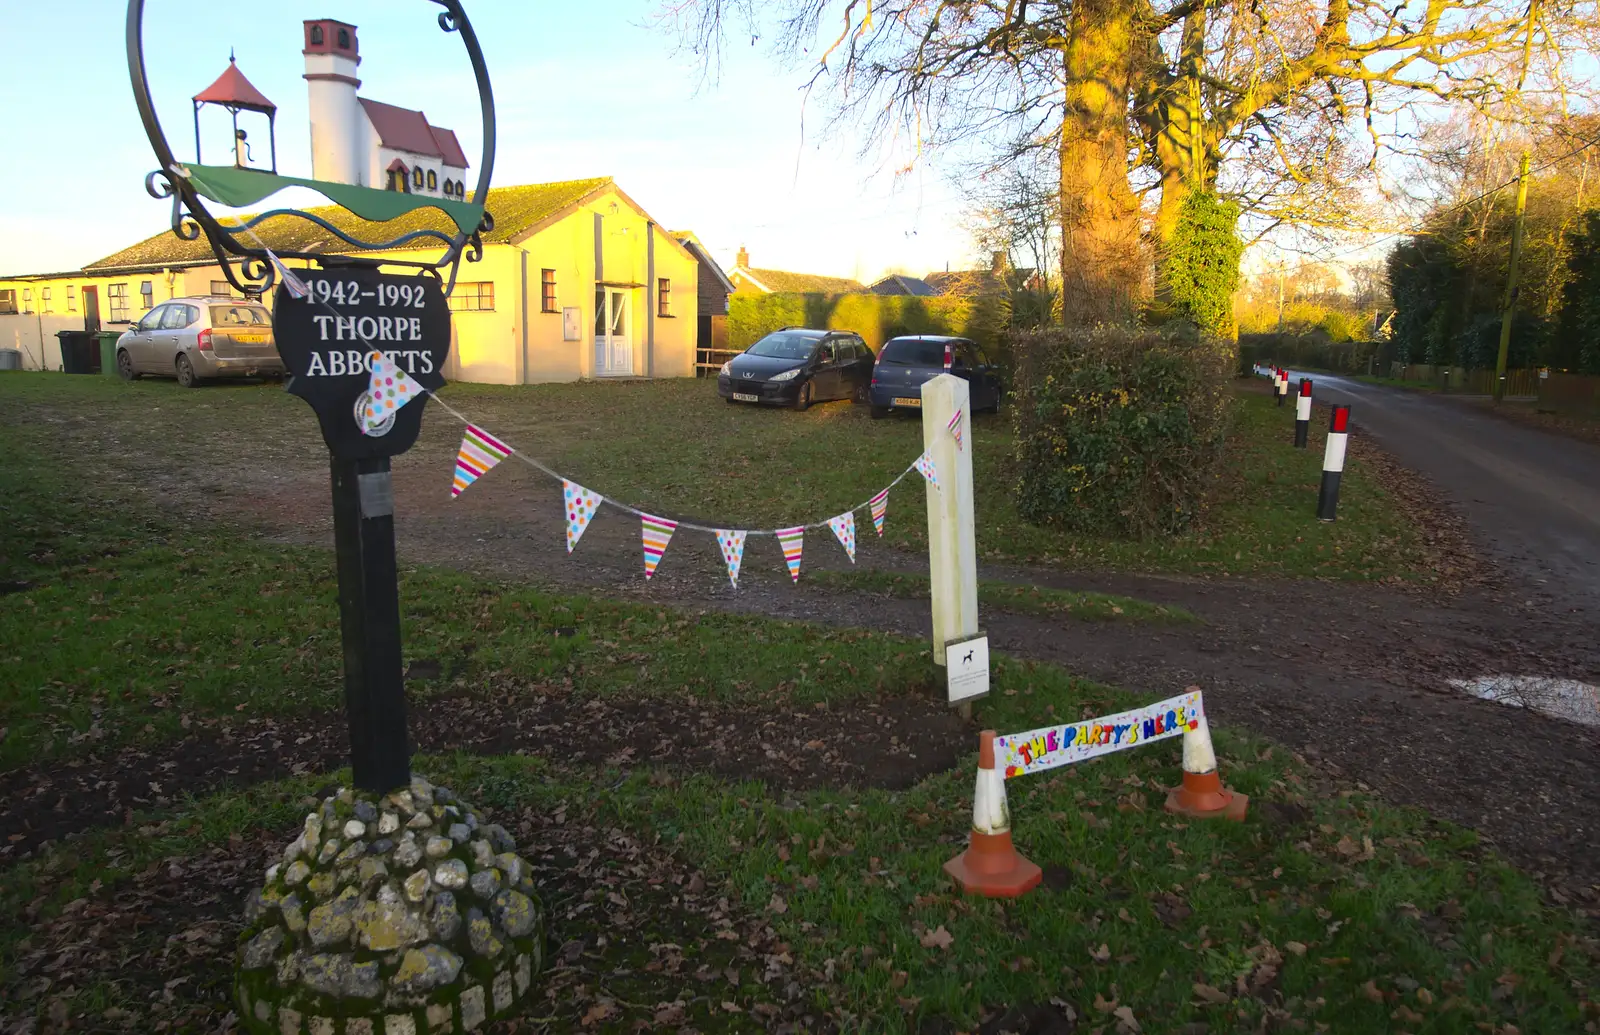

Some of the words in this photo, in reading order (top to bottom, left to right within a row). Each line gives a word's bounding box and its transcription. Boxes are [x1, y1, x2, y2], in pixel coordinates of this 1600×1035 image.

[313, 315, 422, 341] THORPE
[1018, 730, 1059, 766] THE
[1063, 722, 1139, 749] PARTY'S
[1143, 706, 1187, 740] HERE
